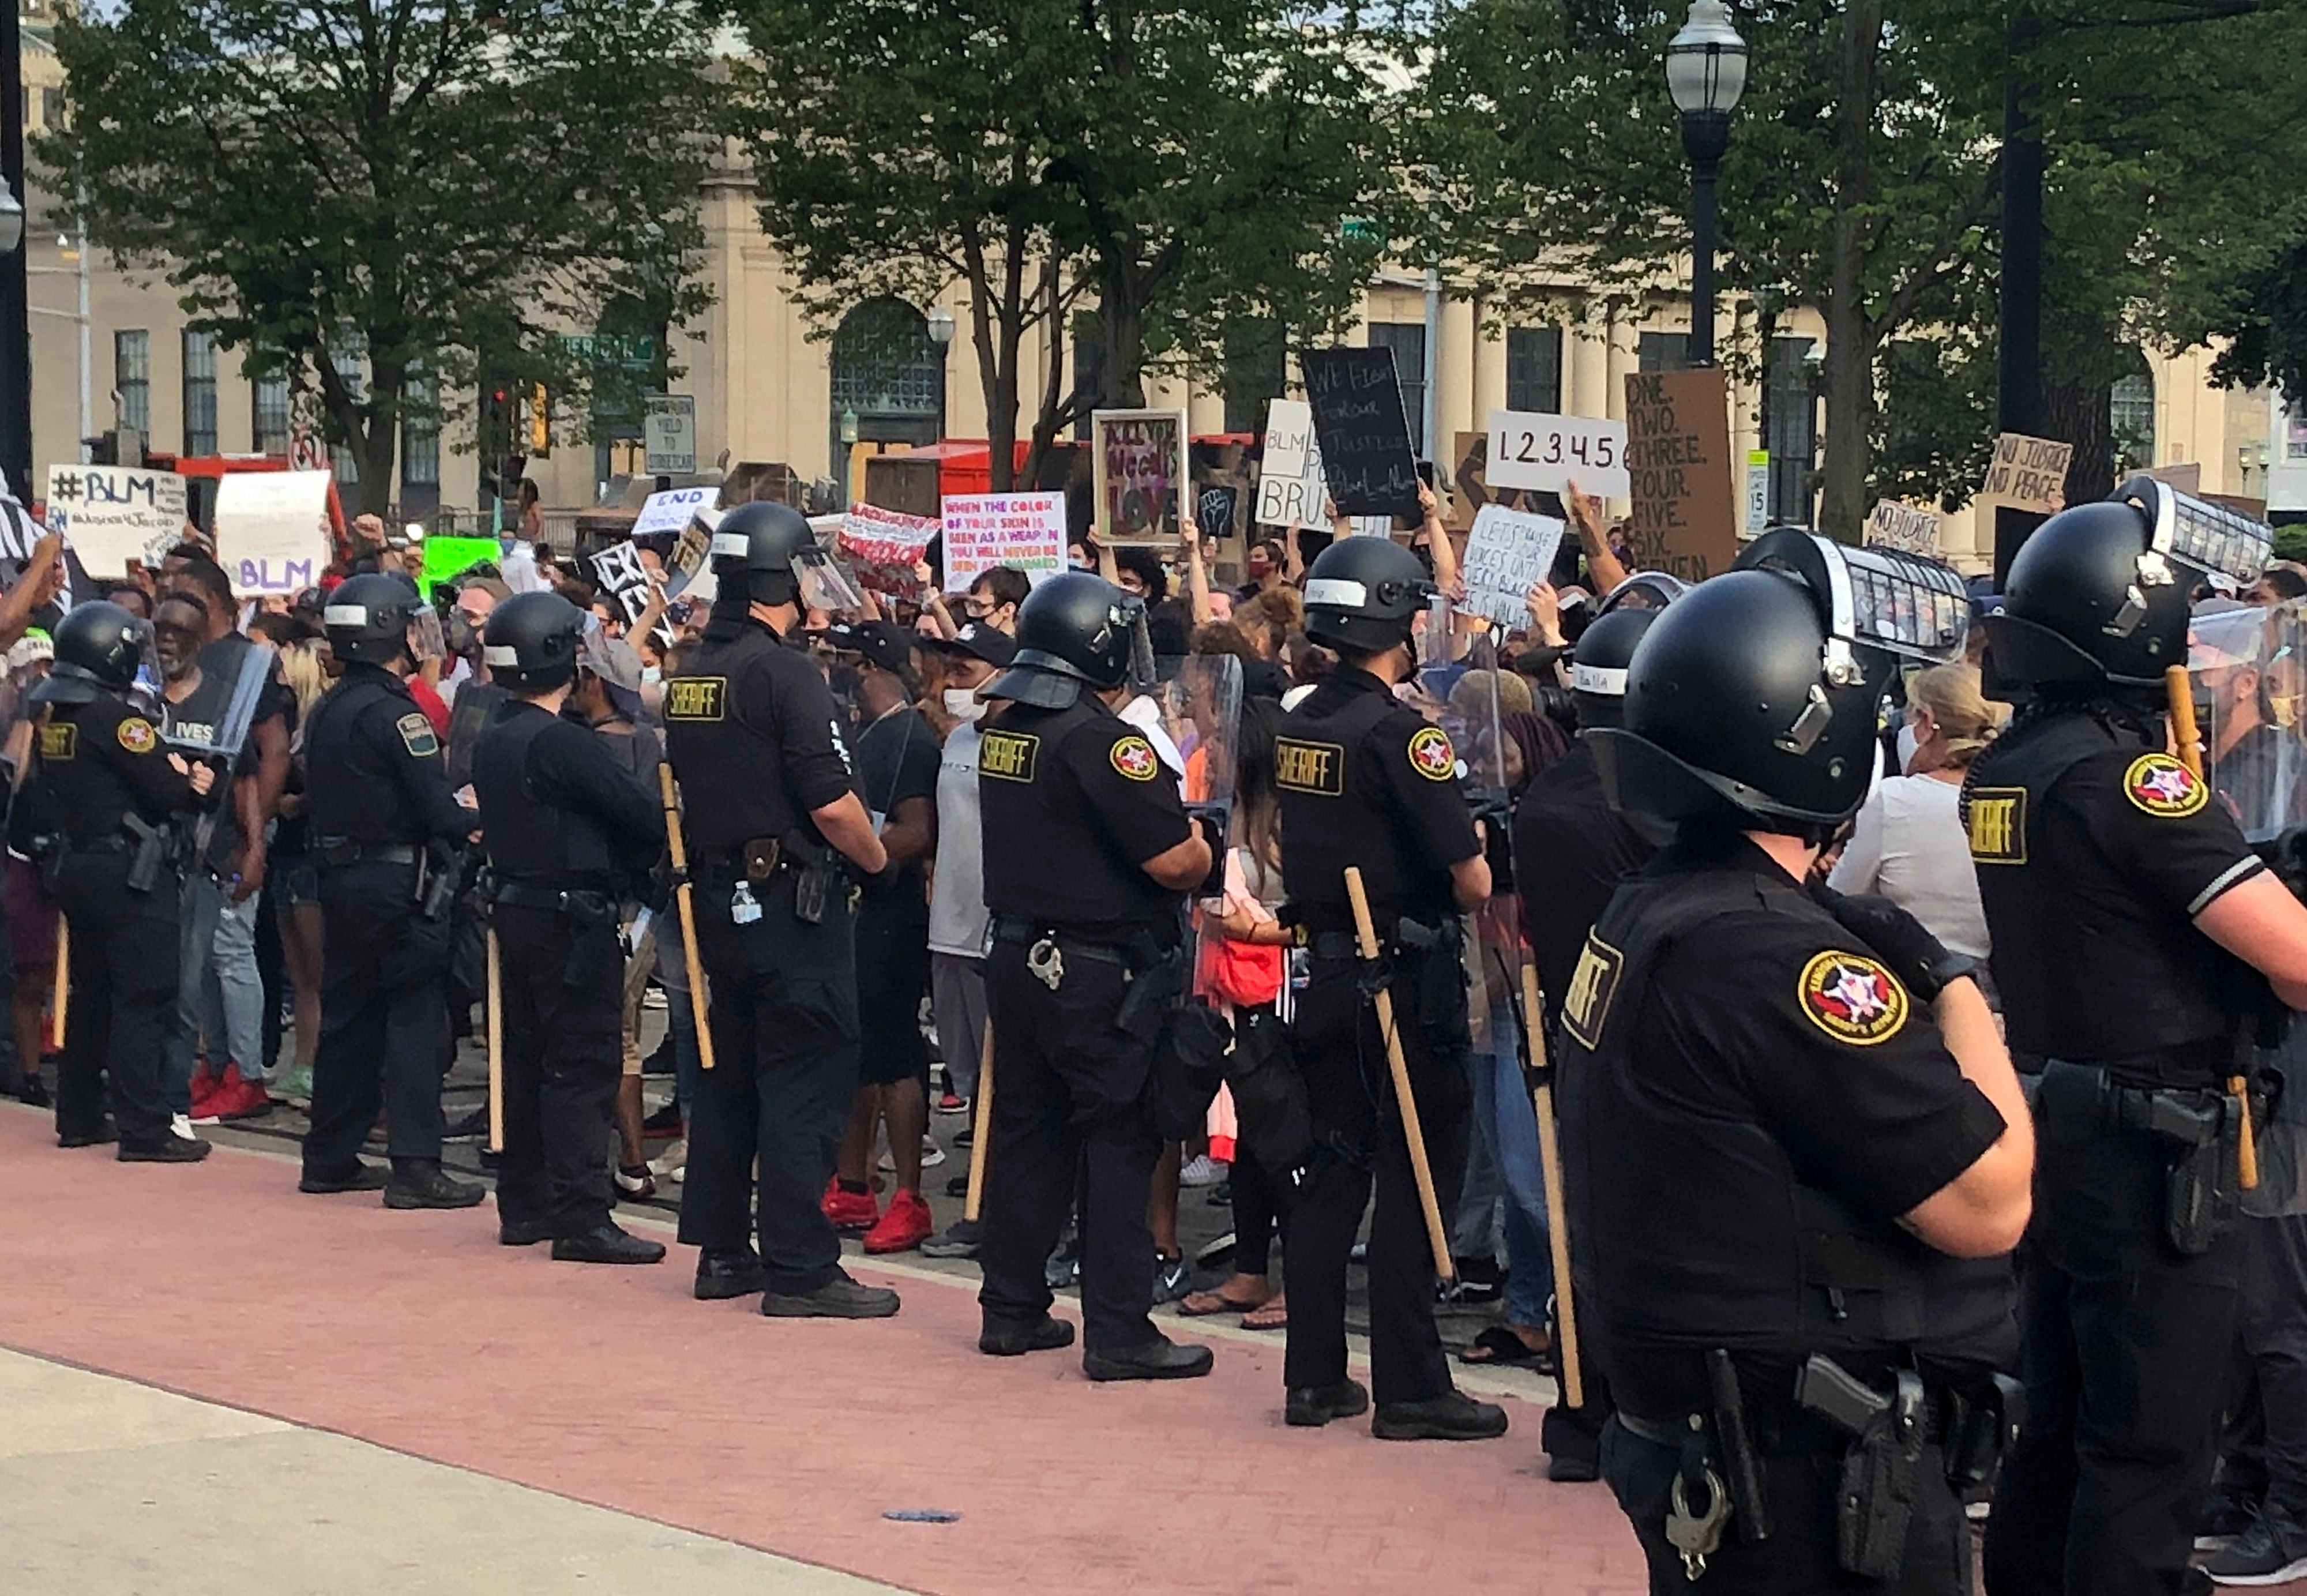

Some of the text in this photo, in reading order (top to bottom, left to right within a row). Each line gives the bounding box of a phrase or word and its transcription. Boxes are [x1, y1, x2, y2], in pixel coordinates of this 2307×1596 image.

[1267, 430, 1305, 453] BLM
[1986, 467, 2010, 493] NO
[51, 471, 155, 508] #BLM
[657, 490, 702, 507] END
[1750, 492, 1764, 511] 15
[945, 501, 1053, 514] WHEN THE COLOR
[947, 517, 1044, 530] OF YOUR SKIN IS
[949, 532, 976, 543] SEEN
[980, 531, 995, 543] AS
[998, 532, 1006, 543] A
[950, 544, 1058, 558] YOU WILL NEVER BE
[240, 558, 311, 589] BLM
[952, 560, 978, 572] SEEN
